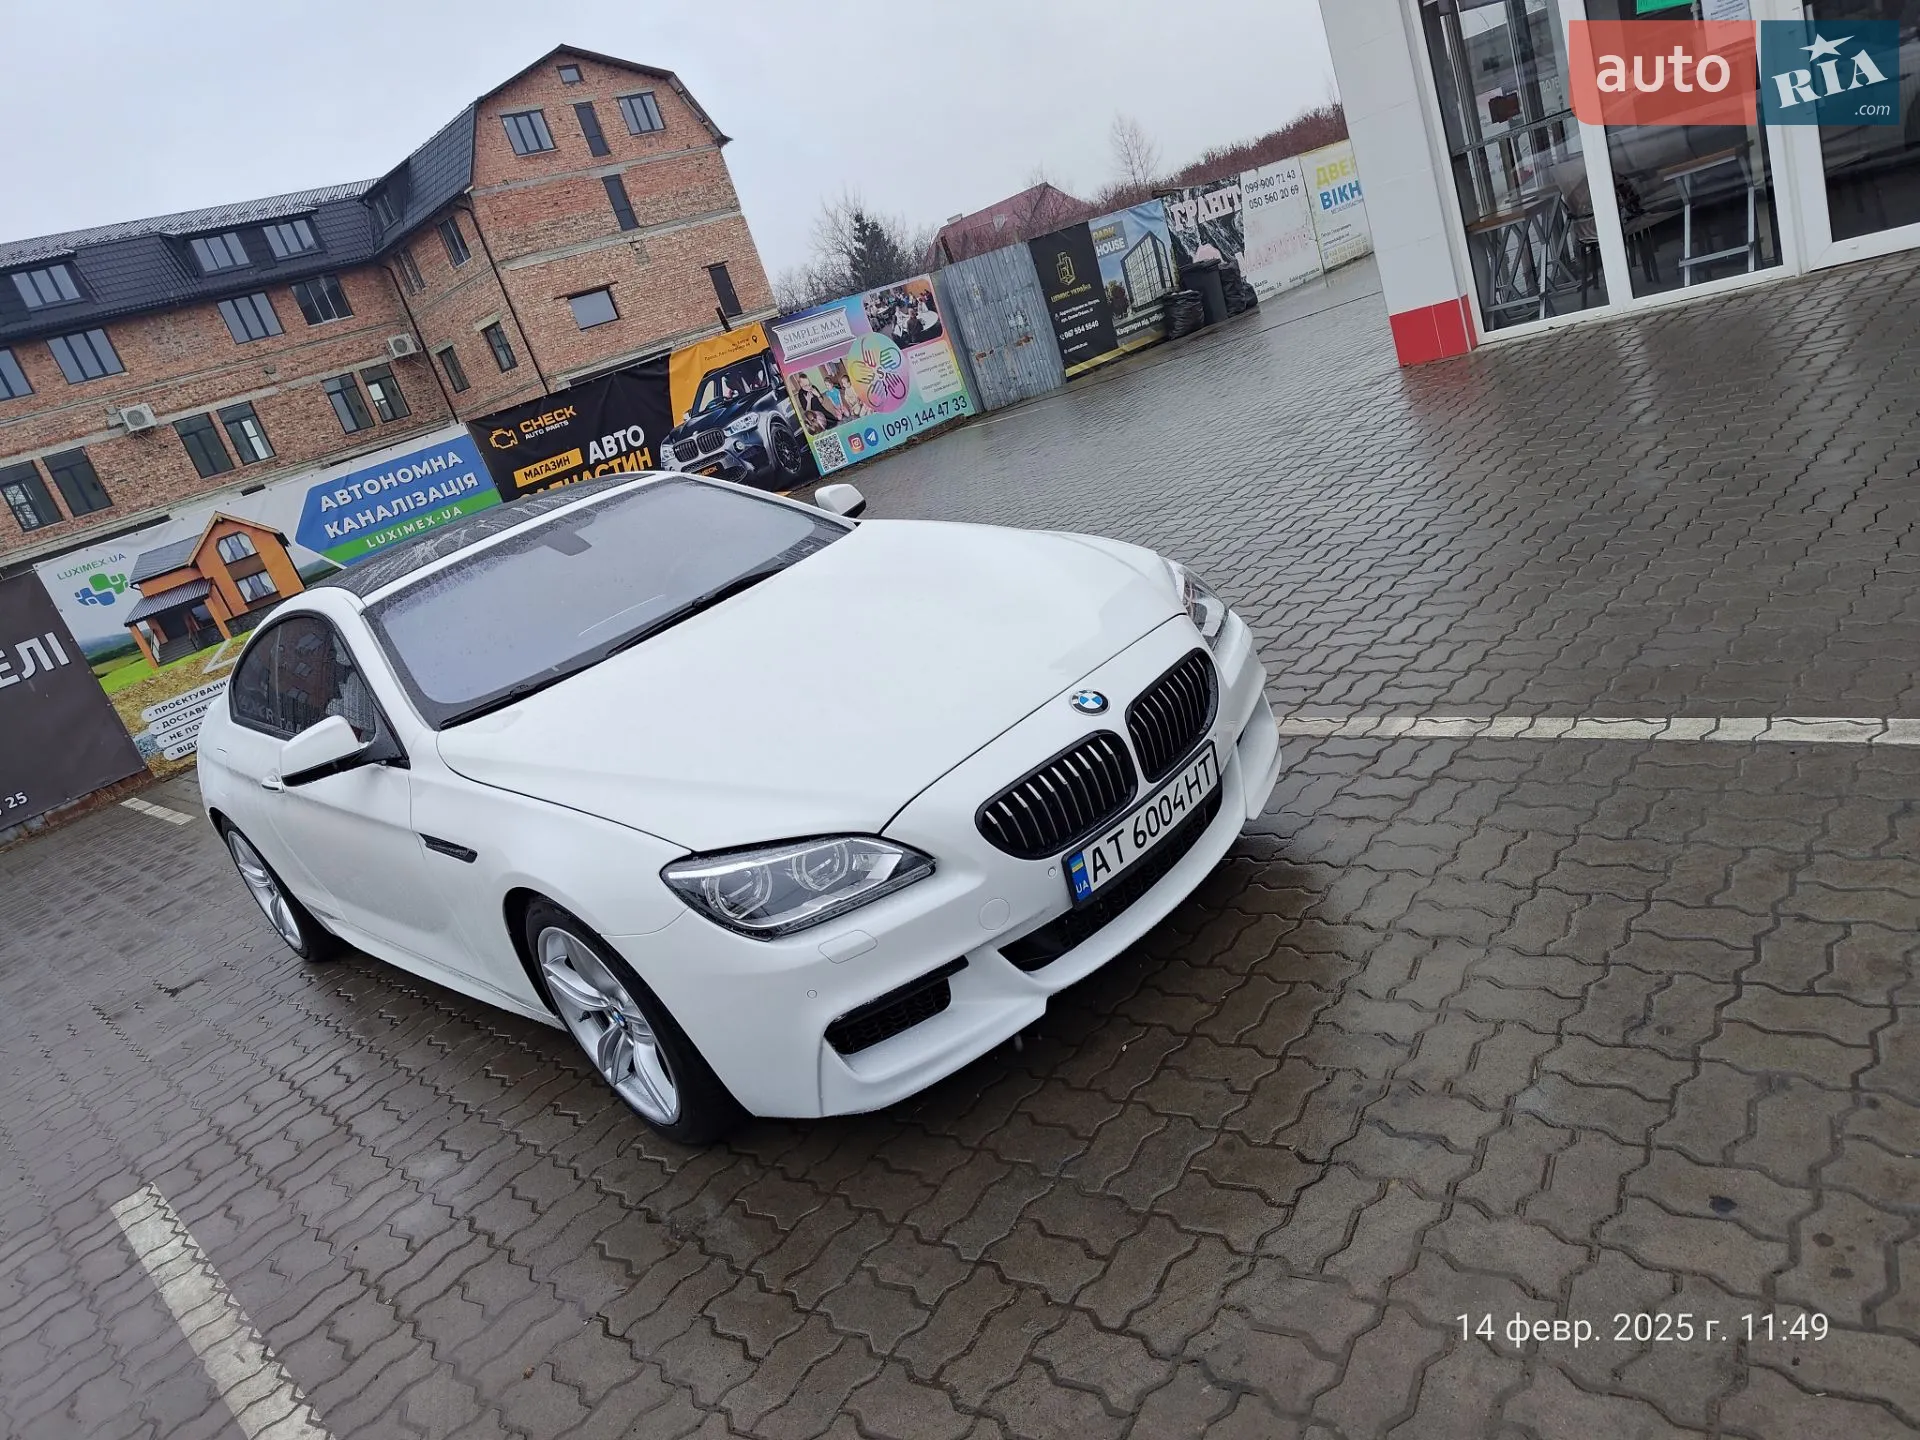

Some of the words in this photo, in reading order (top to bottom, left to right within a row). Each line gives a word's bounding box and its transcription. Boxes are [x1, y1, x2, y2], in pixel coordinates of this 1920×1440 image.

[1096, 237, 1126, 257] HOUSE
[783, 325, 819, 344] SIMPLE
[820, 318, 844, 333] MAX
[520, 405, 577, 433] CHECK
[525, 429, 545, 440] AUTO
[545, 419, 569, 432] PARTS
[882, 416, 914, 441] (099)
[915, 407, 936, 427] 144
[938, 401, 950, 417] 47
[951, 395, 968, 412] 33
[589, 425, 645, 465] АВТО
[524, 456, 571, 481] МАГАЗИН
[321, 451, 464, 513] АВТОНОМНА
[324, 472, 479, 540] КАНАЛІЗАЦІЯ
[154, 680, 229, 715] ПРОЄКТУВАНН
[162, 702, 212, 729] ДОСТАВК
[169, 731, 183, 741] НЕ
[185, 722, 202, 734] ПО
[5, 792, 28, 810] 25
[1075, 879, 1090, 894] UA
